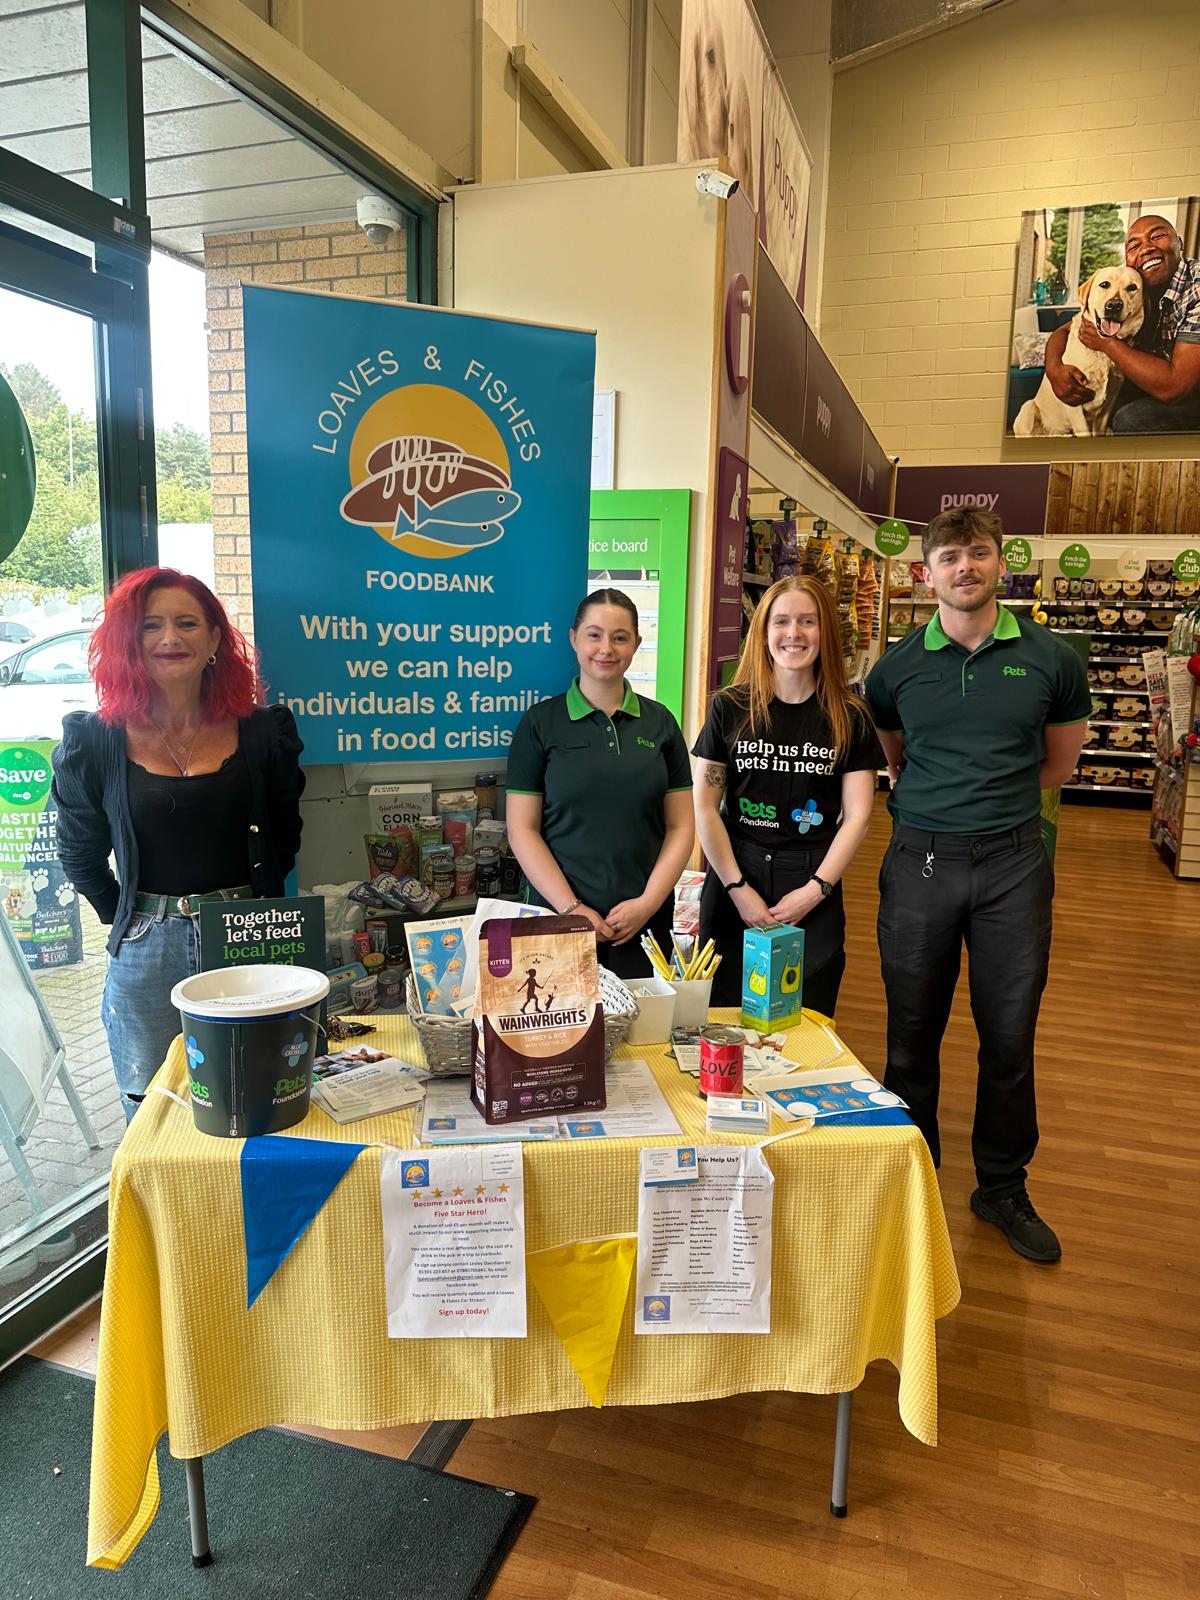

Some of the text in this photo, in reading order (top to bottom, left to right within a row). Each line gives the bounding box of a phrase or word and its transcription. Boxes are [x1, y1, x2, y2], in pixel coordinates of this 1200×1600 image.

[774, 138, 798, 240] Puppy
[312, 346, 541, 462] LOAVES & FISHES
[816, 395, 833, 440] puppy
[612, 538, 648, 553] board
[728, 544, 737, 565] Pet
[1006, 552, 1028, 564] Club
[1178, 564, 1200, 573] Club
[366, 570, 495, 594] FOODBANK
[300, 614, 552, 648] With your support
[346, 656, 513, 683] we can help
[1002, 666, 1027, 676] Pets
[1147, 672, 1164, 681] HELP
[278, 691, 435, 716] individuals
[444, 691, 463, 713] &
[337, 725, 513, 752] in food crisis
[636, 736, 656, 748] Pets
[737, 739, 837, 760] Help us feed
[735, 756, 768, 772] pets
[772, 756, 790, 772] in
[0, 766, 47, 784] Save
[739, 797, 777, 820] Pets
[382, 813, 421, 824] CORN
[739, 816, 780, 829] Foundation
[222, 909, 305, 928] Together,
[226, 924, 302, 943] let's feed
[224, 943, 266, 960] local
[270, 942, 306, 959] pets
[490, 958, 510, 966] KITTEN
[700, 1061, 738, 1077] LOVE
[274, 1074, 307, 1096] Pets
[272, 1086, 307, 1105] Foundation
[450, 1198, 476, 1206] Loaves
[434, 1210, 449, 1218] Five
[467, 1208, 487, 1216] Hero!
[439, 1309, 454, 1317] Sign
[466, 1308, 489, 1316] today!
